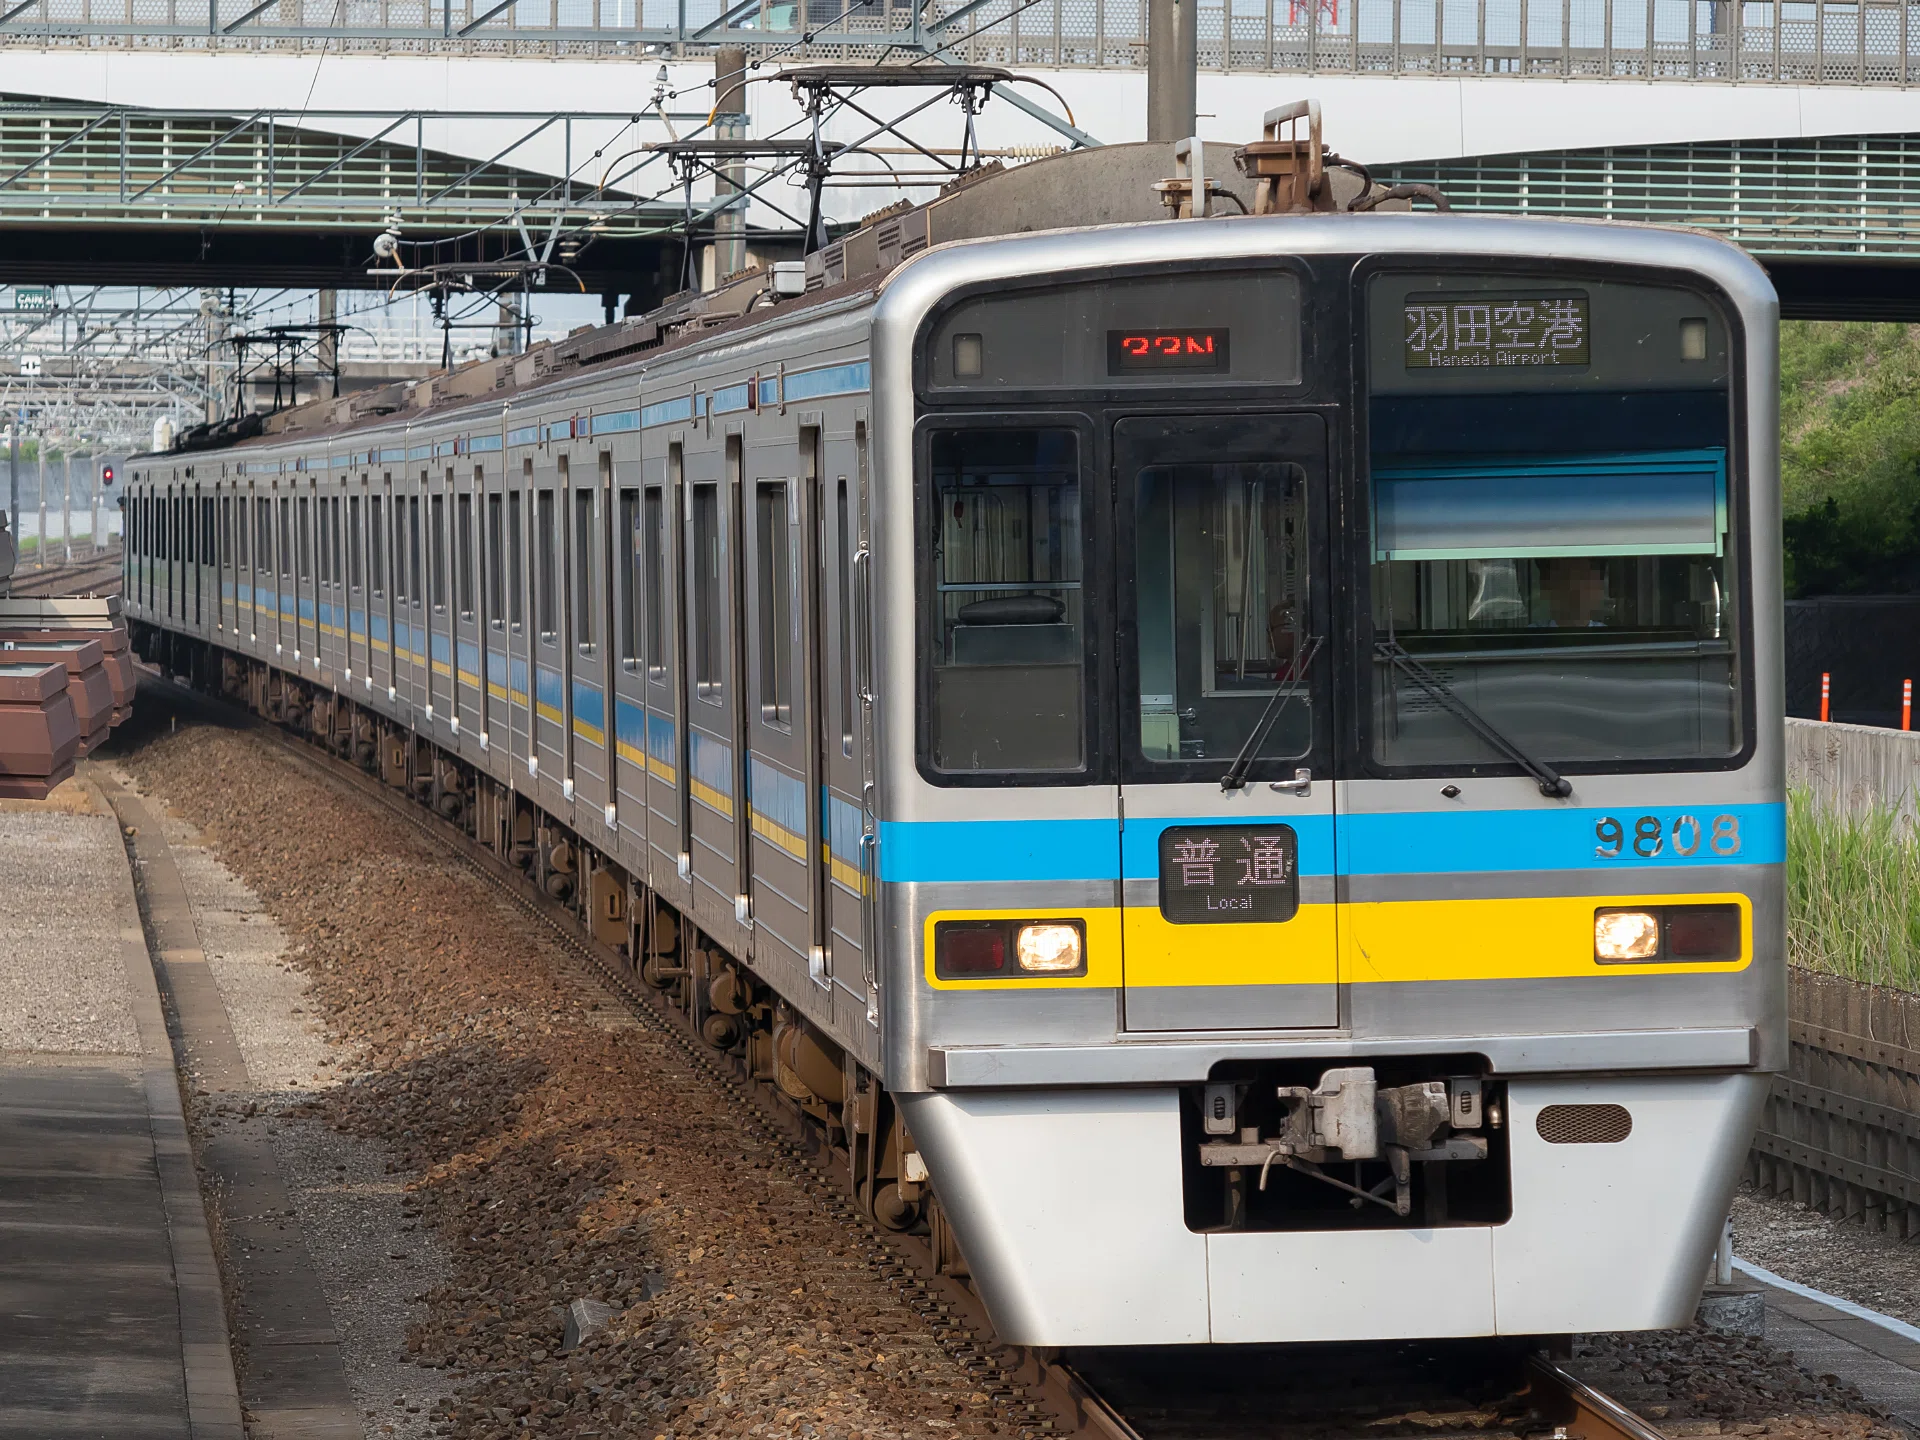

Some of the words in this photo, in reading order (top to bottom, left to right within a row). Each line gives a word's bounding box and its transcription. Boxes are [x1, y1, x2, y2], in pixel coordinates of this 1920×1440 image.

[1404, 299, 1583, 351] 羽田空港
[1429, 351, 1490, 366] Haneda
[1496, 349, 1561, 365] Airport
[1595, 813, 1742, 859] 9808
[1172, 836, 1286, 886] 普通
[1206, 894, 1253, 910] Local
